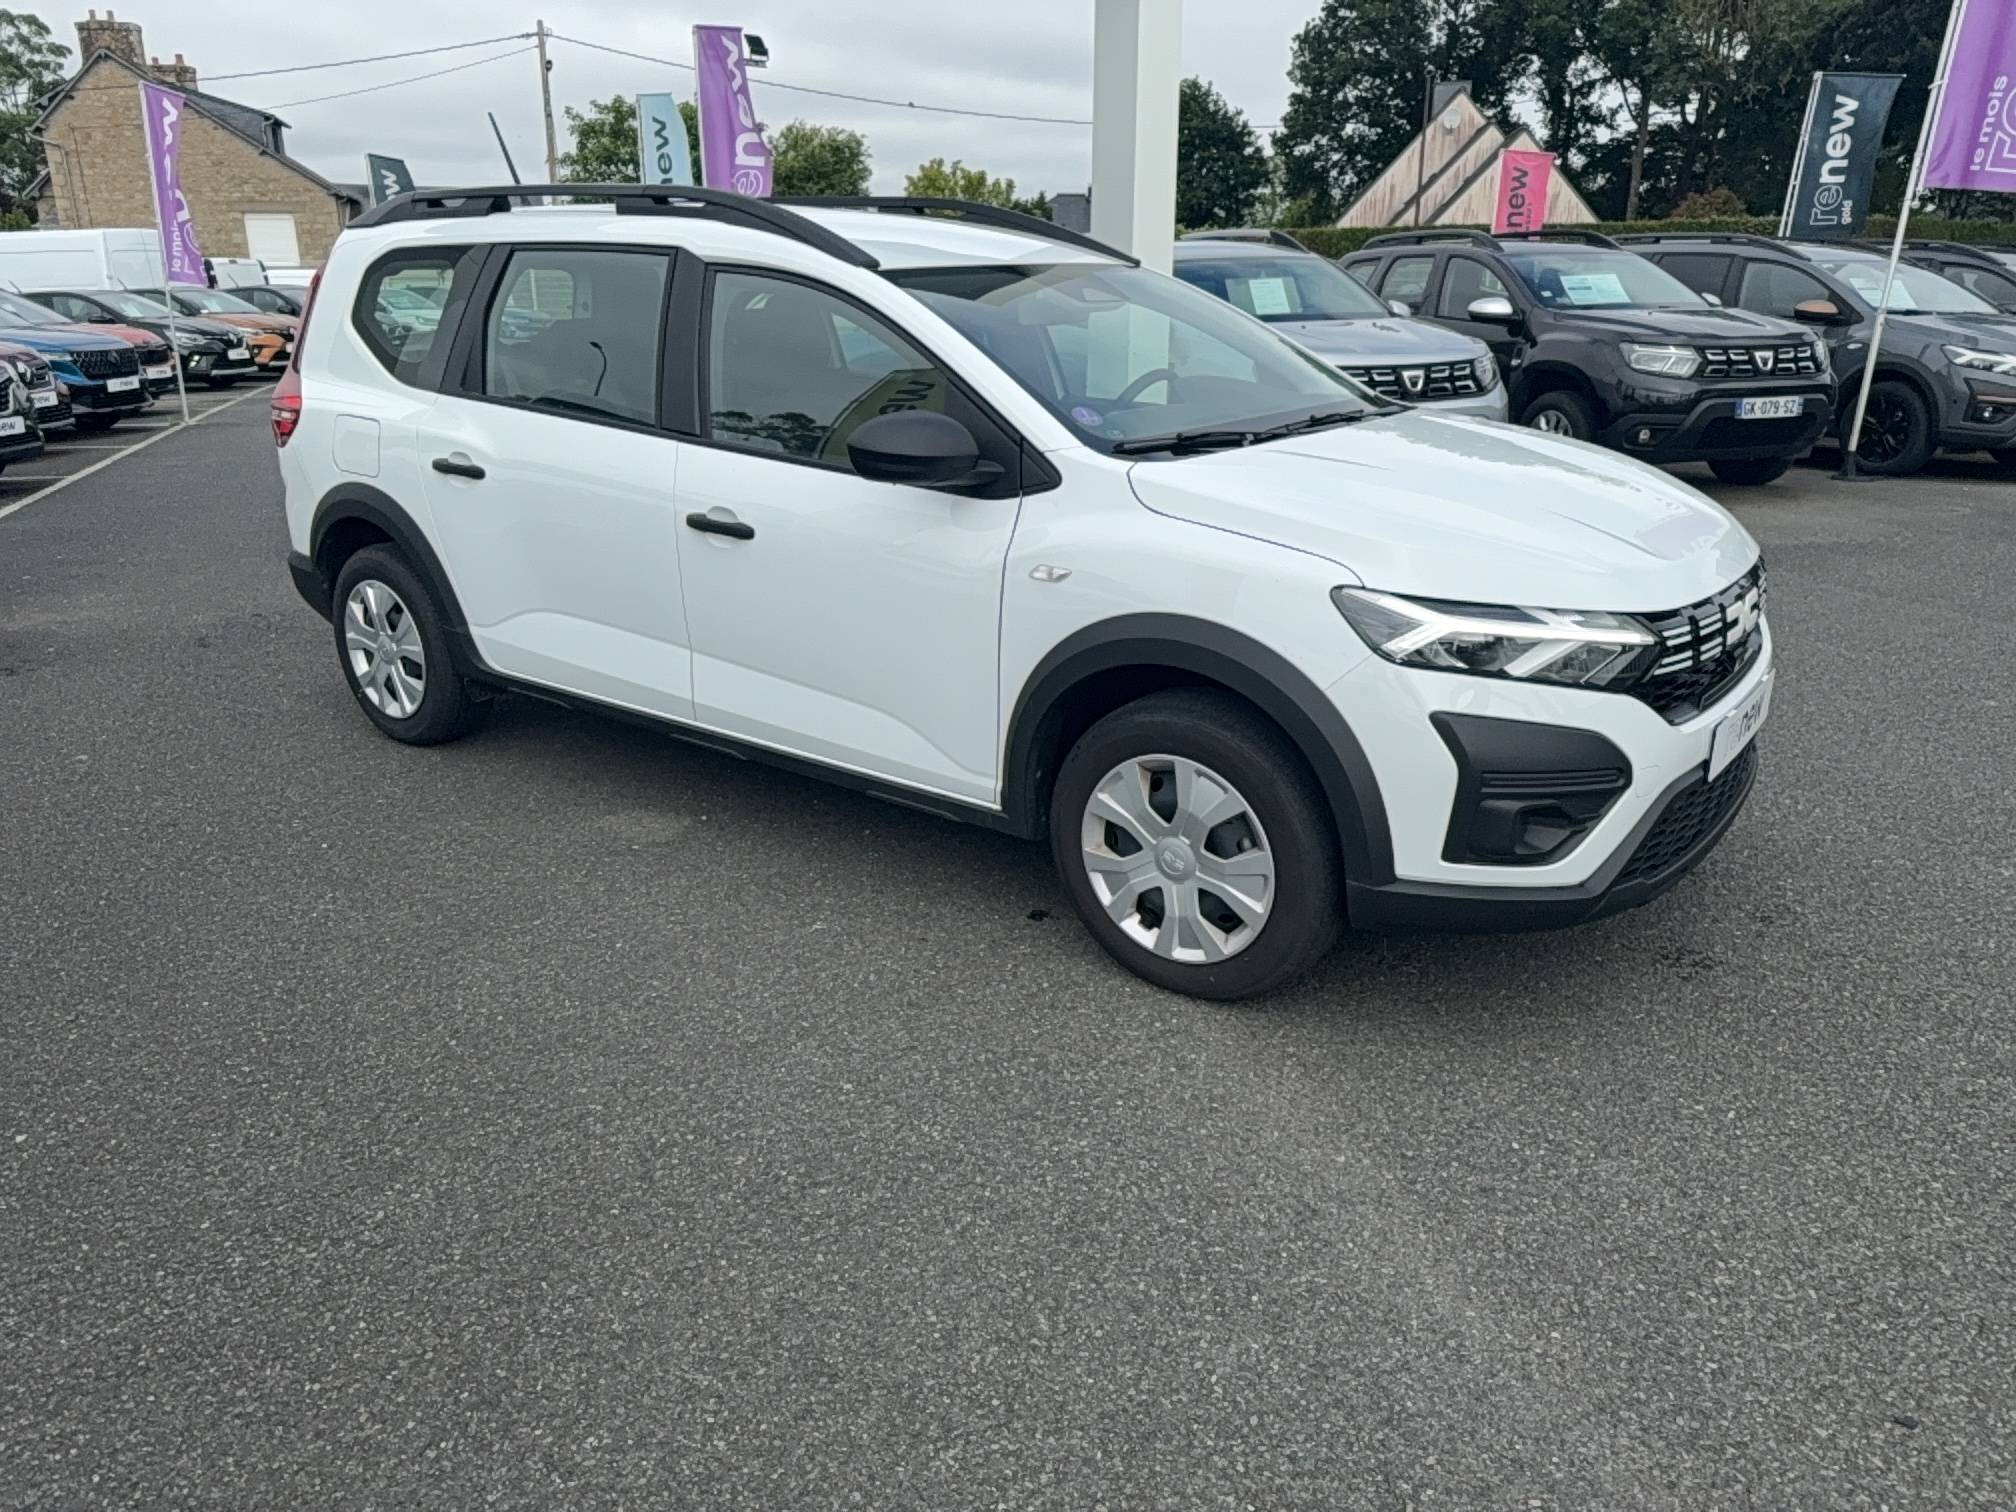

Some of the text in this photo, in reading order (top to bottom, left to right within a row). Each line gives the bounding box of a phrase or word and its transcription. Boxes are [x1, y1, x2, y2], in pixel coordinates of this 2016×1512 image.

[1969, 75, 2008, 171] le mois
[1809, 94, 1860, 226] renew
[1841, 200, 1853, 225] gold
[1743, 399, 1797, 416] GK-079-SZ
